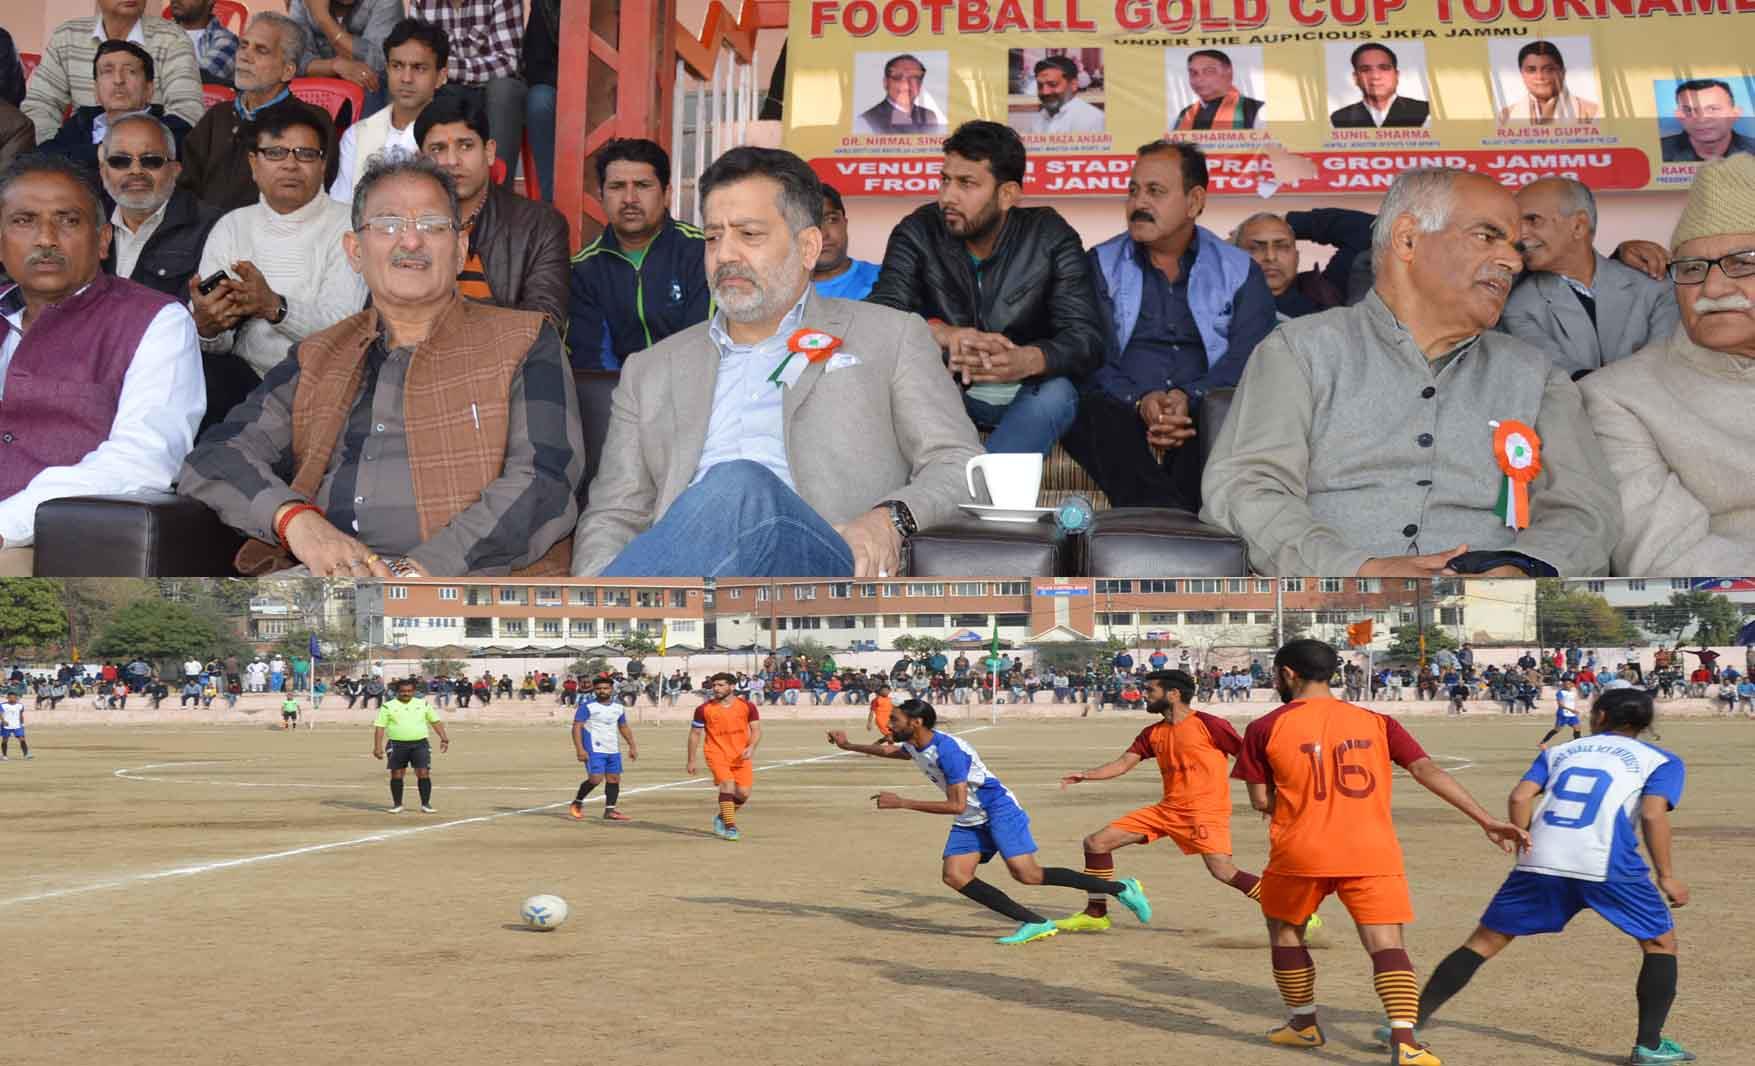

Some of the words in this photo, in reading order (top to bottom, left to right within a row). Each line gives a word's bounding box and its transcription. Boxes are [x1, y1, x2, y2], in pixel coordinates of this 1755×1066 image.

[809, 0, 1097, 38] FOOTBALL
[1114, 0, 1270, 34] GOLD
[1288, 0, 1407, 26] CUP
[1113, 38, 1191, 47] UNDER
[1194, 36, 1241, 46] THE
[1248, 30, 1372, 45] AUPICIOUS
[1379, 29, 1438, 40] JKFA
[1444, 26, 1529, 39] JAMMU
[865, 136, 913, 146] NIRMAL
[1191, 131, 1246, 142] SHARMA
[1331, 130, 1370, 140] SUNIL
[1375, 129, 1432, 140] SHARMA
[1496, 127, 1550, 138] RAJESH
[1554, 126, 1600, 137] GUPTA
[835, 161, 944, 175] VENUE
[1322, 155, 1477, 172] GROUND,
[1487, 152, 1613, 169] JAMMU
[1498, 171, 1579, 187] 20
[1300, 739, 1376, 801] 16
[1542, 766, 1613, 829] 9
